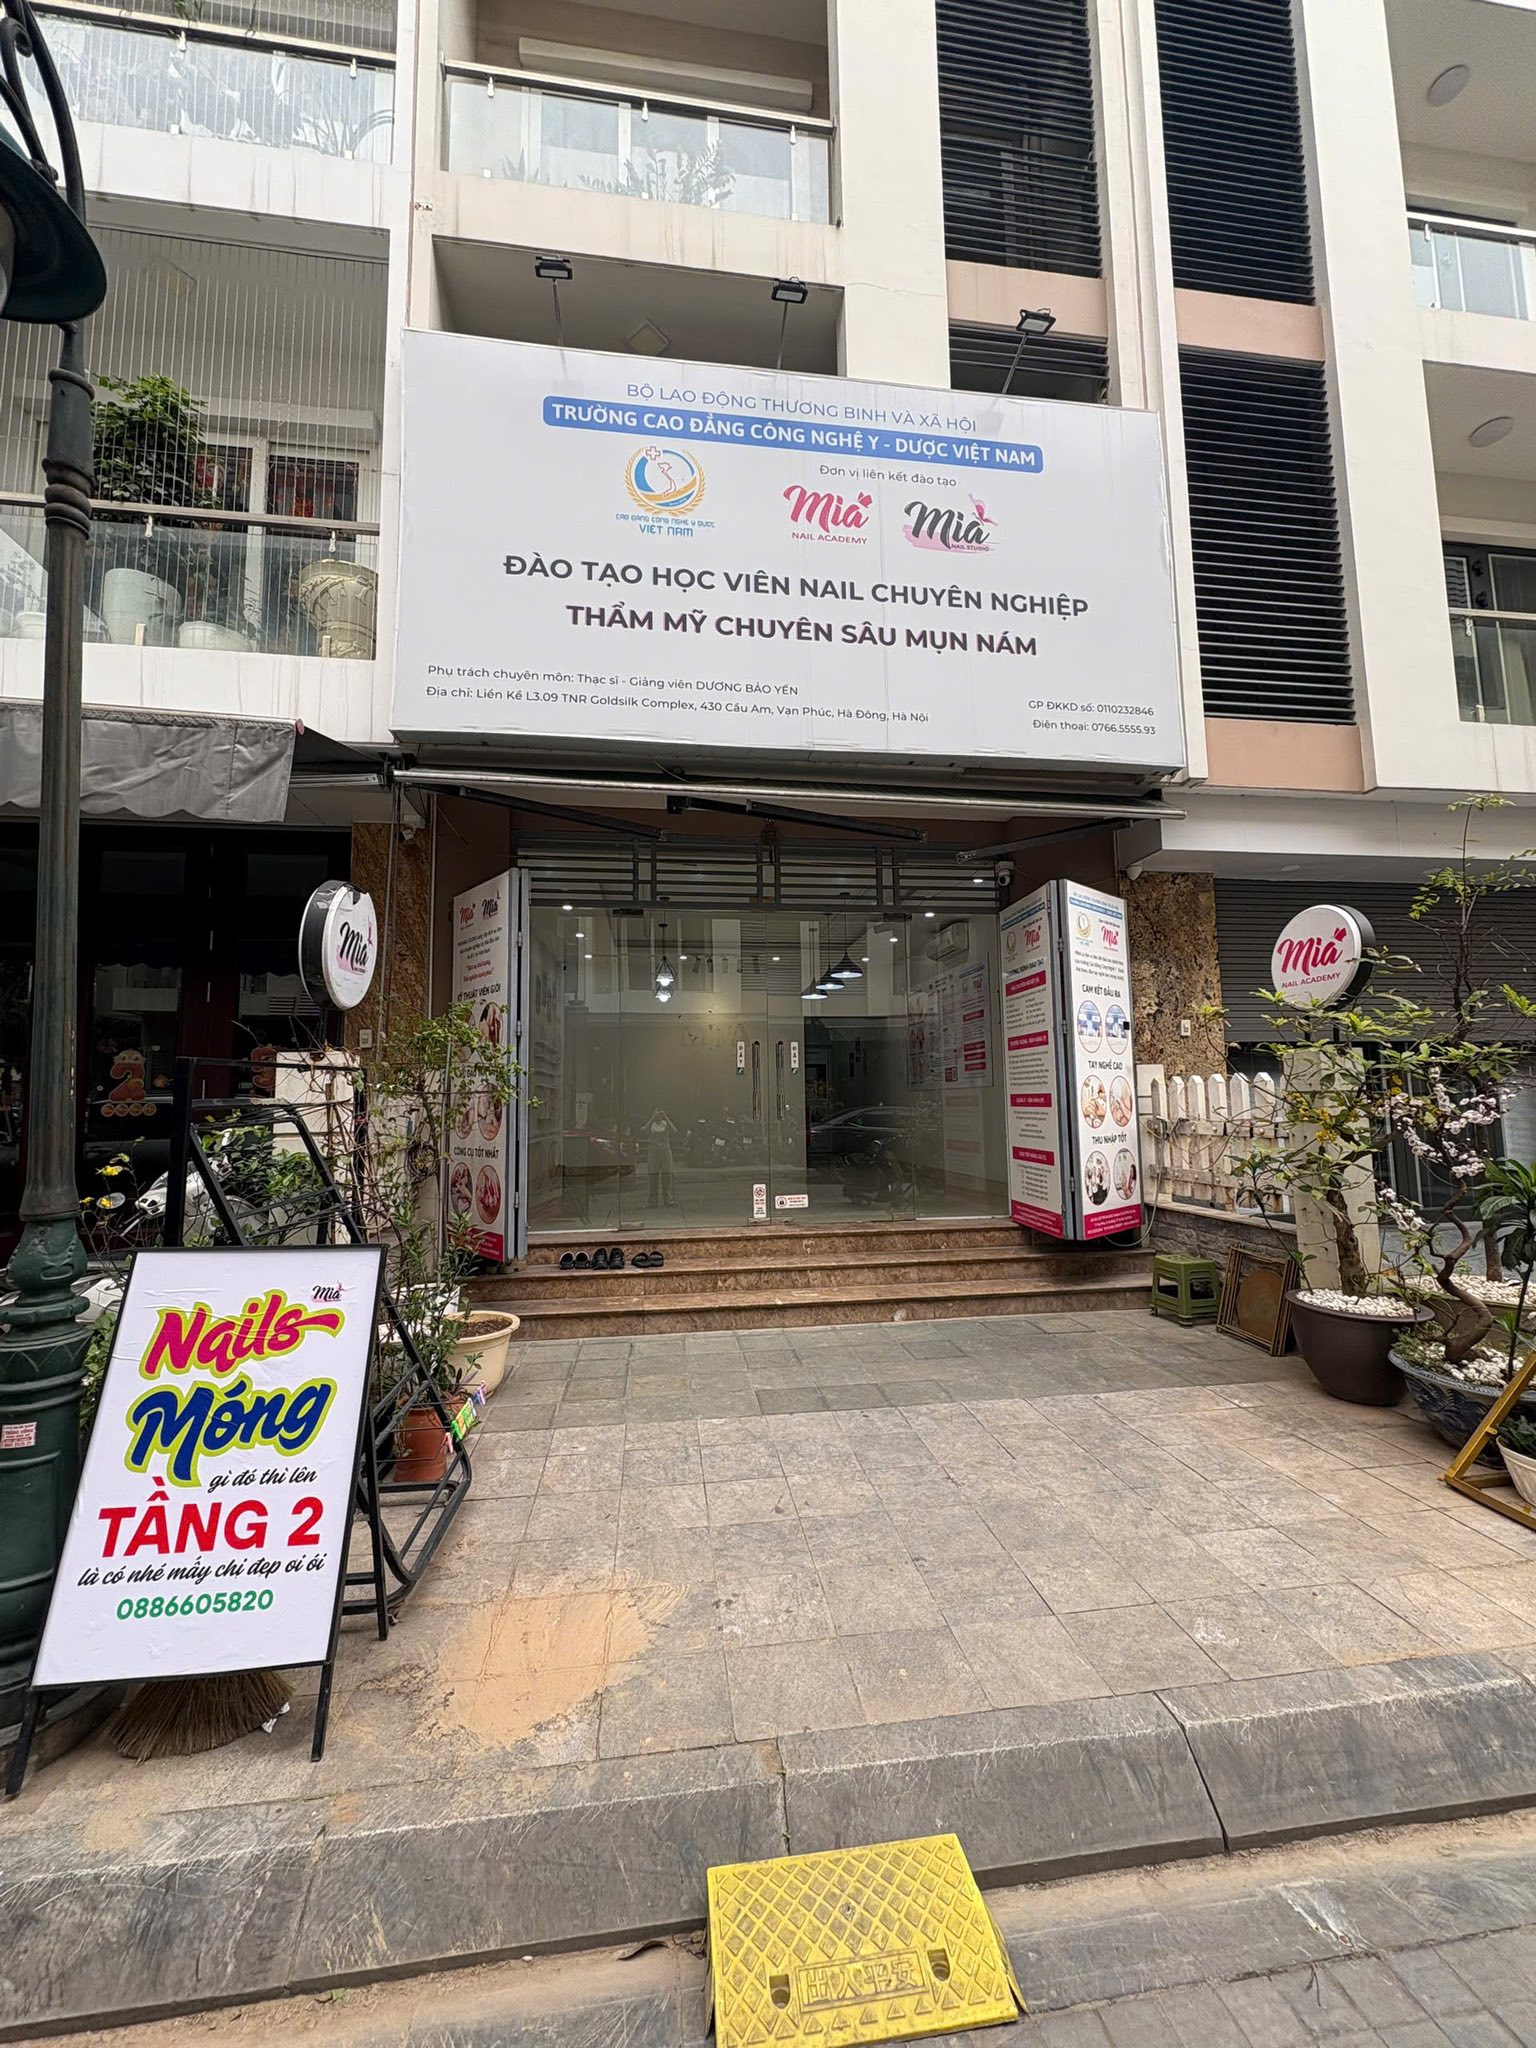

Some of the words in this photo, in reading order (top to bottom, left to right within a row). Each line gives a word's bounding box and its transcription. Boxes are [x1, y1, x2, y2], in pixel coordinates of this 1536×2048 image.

[627, 383, 653, 401] BỘ
[660, 387, 696, 403] LAO
[702, 391, 756, 409] ĐỘNG
[762, 397, 838, 417] THƯƠNG
[844, 406, 886, 423] BINH
[891, 410, 915, 425] VÀ
[919, 413, 942, 429] XÃ
[947, 416, 976, 434] HỘI
[552, 403, 637, 427] TRƯỜNG
[643, 413, 684, 431] CAO
[690, 412, 744, 437] ĐẲNG
[750, 421, 804, 443] CÔNG
[811, 428, 863, 452] NGHỆ
[868, 436, 879, 449] Y
[896, 438, 948, 459] DƯỢC
[952, 442, 993, 464] VIỆT
[996, 449, 1035, 466] NAM
[820, 464, 845, 476] Đơn
[849, 467, 859, 479] vị
[862, 468, 885, 480] liên
[888, 470, 907, 482] kết
[911, 472, 933, 484] đào
[937, 475, 956, 487] tạo
[783, 485, 869, 533] Mia
[667, 525, 693, 537] NAM
[792, 531, 815, 541] NAIL
[817, 533, 867, 545] ACADEMY
[904, 501, 990, 549] Mia
[503, 552, 573, 577] ĐÀO
[581, 561, 643, 588] TẠO
[652, 566, 716, 593] HỌC
[723, 569, 790, 596] VIÊN
[800, 577, 864, 601] NAIL
[871, 583, 982, 610] CHUYÊN
[990, 592, 1089, 621] NGHIỆP
[566, 600, 654, 631] THẨM
[664, 609, 707, 634] MỸ
[714, 615, 833, 643] CHUYÊN
[841, 620, 897, 647] SÂU
[905, 628, 968, 655] MỤN
[976, 631, 1037, 656] NÁM
[428, 665, 453, 677] Phụ
[457, 666, 490, 678] trách
[493, 669, 539, 681] chuyên
[543, 672, 574, 683] môn:
[577, 673, 606, 685] Thạc
[629, 676, 664, 689] Giảng
[667, 679, 692, 690] viên
[696, 680, 742, 693] DƯƠNG
[745, 682, 772, 694] BẢO
[426, 686, 448, 698] Địa
[451, 686, 473, 698] chỉ:
[526, 692, 558, 702] L3.09
[562, 693, 587, 704] TNR
[590, 695, 638, 707] Goldsilk
[641, 697, 697, 710] Complex,
[700, 701, 722, 712] 430
[751, 703, 774, 715] Am,
[776, 705, 799, 717] Vạn
[802, 706, 834, 718] Phúc,
[837, 707, 853, 719] Hà
[855, 708, 889, 722] Đông,
[892, 710, 907, 722] Hà
[910, 710, 929, 724] Nội
[1028, 700, 1044, 710] GP
[1046, 700, 1078, 711] ĐKKD
[1081, 702, 1095, 713] số:
[1097, 704, 1155, 716] 0110232846
[1032, 719, 1057, 731] Điện
[1060, 720, 1089, 733] thoại:
[1091, 722, 1156, 735] 0766.5555.93
[340, 921, 369, 971] Mia
[1277, 937, 1343, 976] Mia
[1082, 984, 1093, 994] CAM
[1114, 989, 1121, 998] RA
[1282, 980, 1298, 989] NAIL
[1300, 972, 1341, 986] ACADEMY
[1088, 1060, 1097, 1069] TAY
[1112, 1061, 1123, 1070] CAO
[1092, 1136, 1103, 1145] THU
[312, 1285, 342, 1302] Mia
[141, 1291, 342, 1378] Nails
[126, 1374, 336, 1485] Móng
[208, 1470, 232, 1493] gì
[232, 1467, 256, 1486] đó
[259, 1467, 288, 1486] thì
[288, 1466, 317, 1484] lên
[98, 1476, 268, 1557] TẦNG
[287, 1496, 323, 1547] 2
[77, 1567, 101, 1587] là
[101, 1565, 126, 1585] có
[126, 1562, 166, 1584] nhé
[167, 1556, 212, 1586] mấy
[214, 1557, 245, 1579] chị
[246, 1557, 281, 1579] đẹp
[116, 1589, 274, 1620] 0886605820
[806, 1959, 918, 2004] 出入平安
